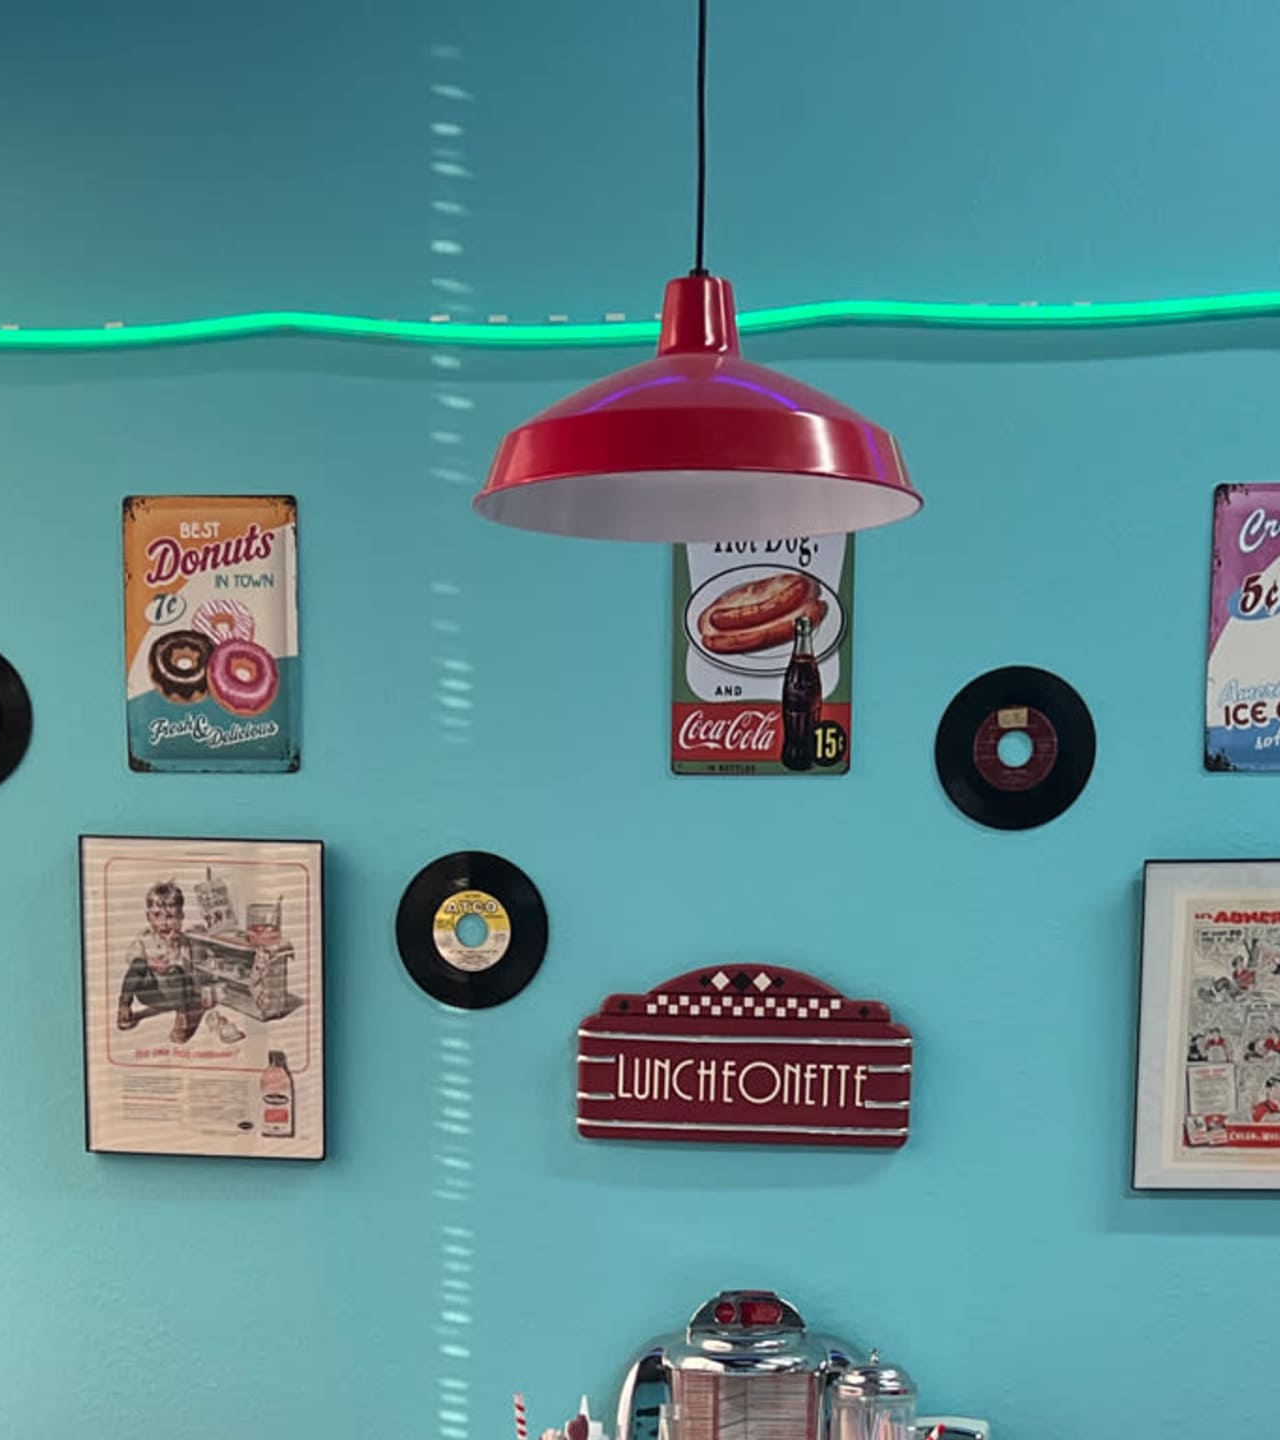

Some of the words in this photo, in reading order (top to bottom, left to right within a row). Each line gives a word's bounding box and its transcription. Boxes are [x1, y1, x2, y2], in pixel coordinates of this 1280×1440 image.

[179, 521, 221, 540] BEST
[146, 524, 275, 585] Donuts
[214, 574, 228, 589] IN
[234, 573, 275, 589] TOWN
[1239, 574, 1280, 616] 5¢
[714, 685, 743, 698] AND
[148, 713, 193, 745] Fresh
[193, 713, 210, 739] &
[209, 718, 279, 749] Delicious
[678, 710, 782, 752] Coca-Cola
[1223, 702, 1267, 728] ICE
[617, 1052, 868, 1108] LUNCHEONETTE
